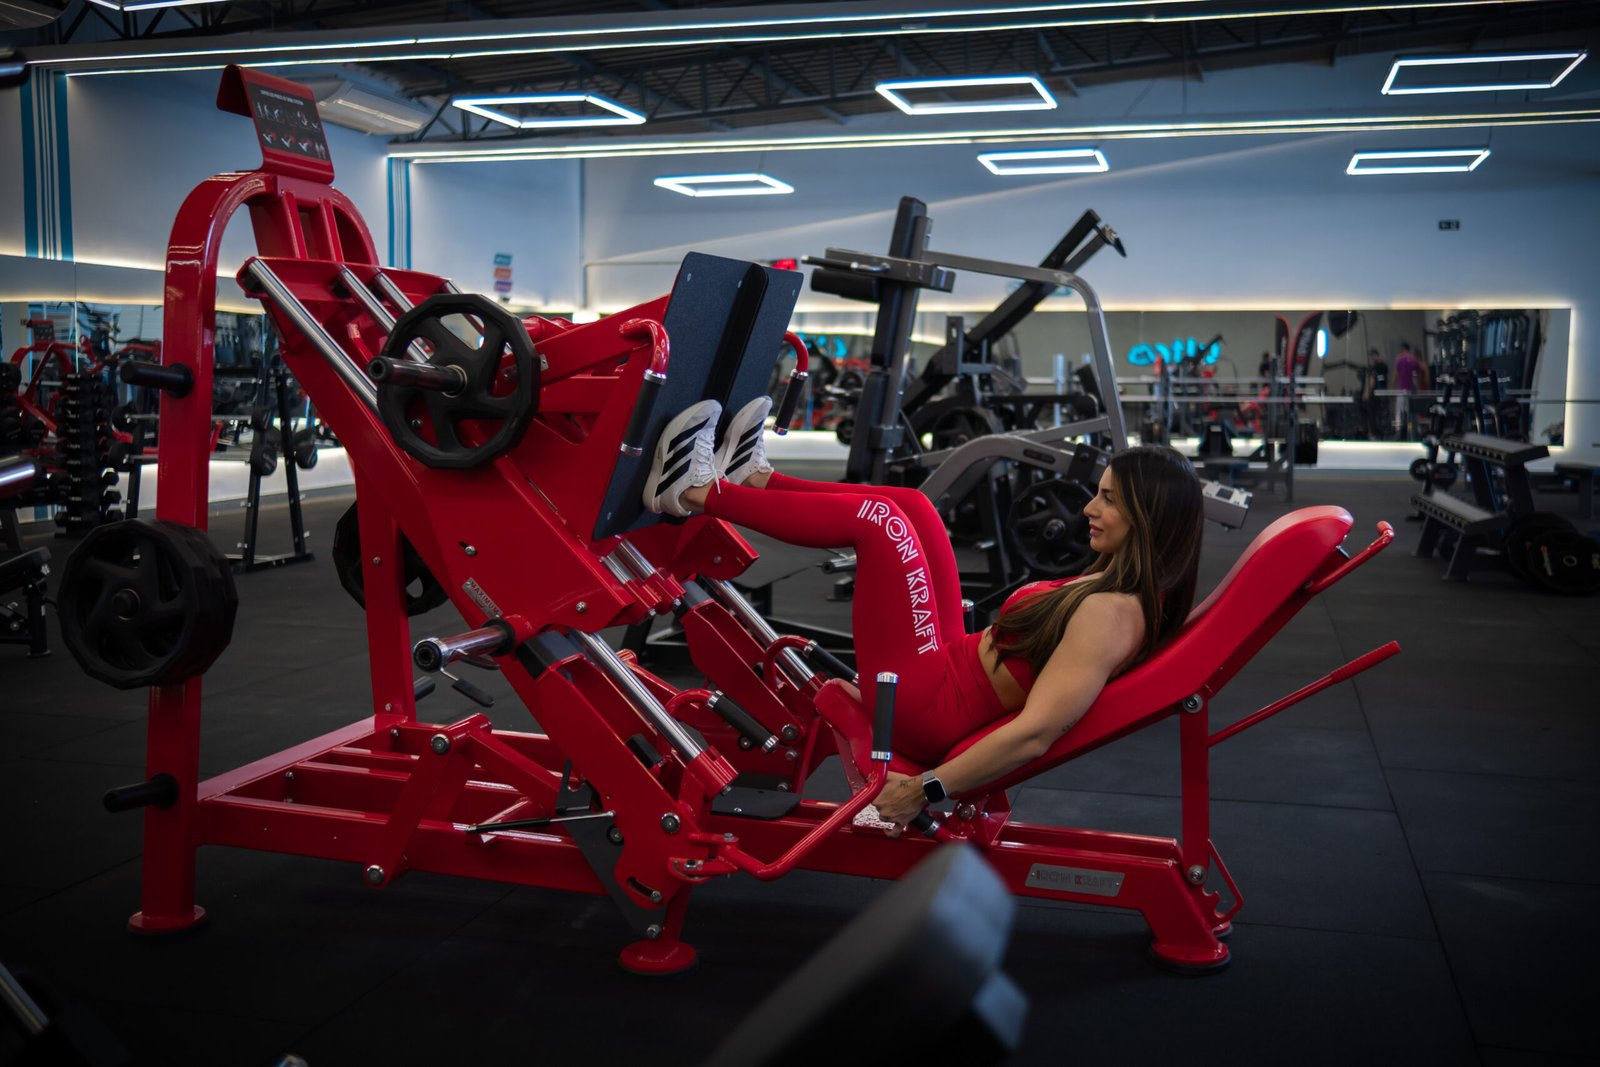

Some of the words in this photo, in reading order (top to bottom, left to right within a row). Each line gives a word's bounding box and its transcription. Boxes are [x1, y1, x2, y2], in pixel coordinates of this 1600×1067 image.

[470, 581, 500, 615] MAXIMUM
[856, 499, 919, 564] IRON
[905, 567, 939, 655] KRAFT
